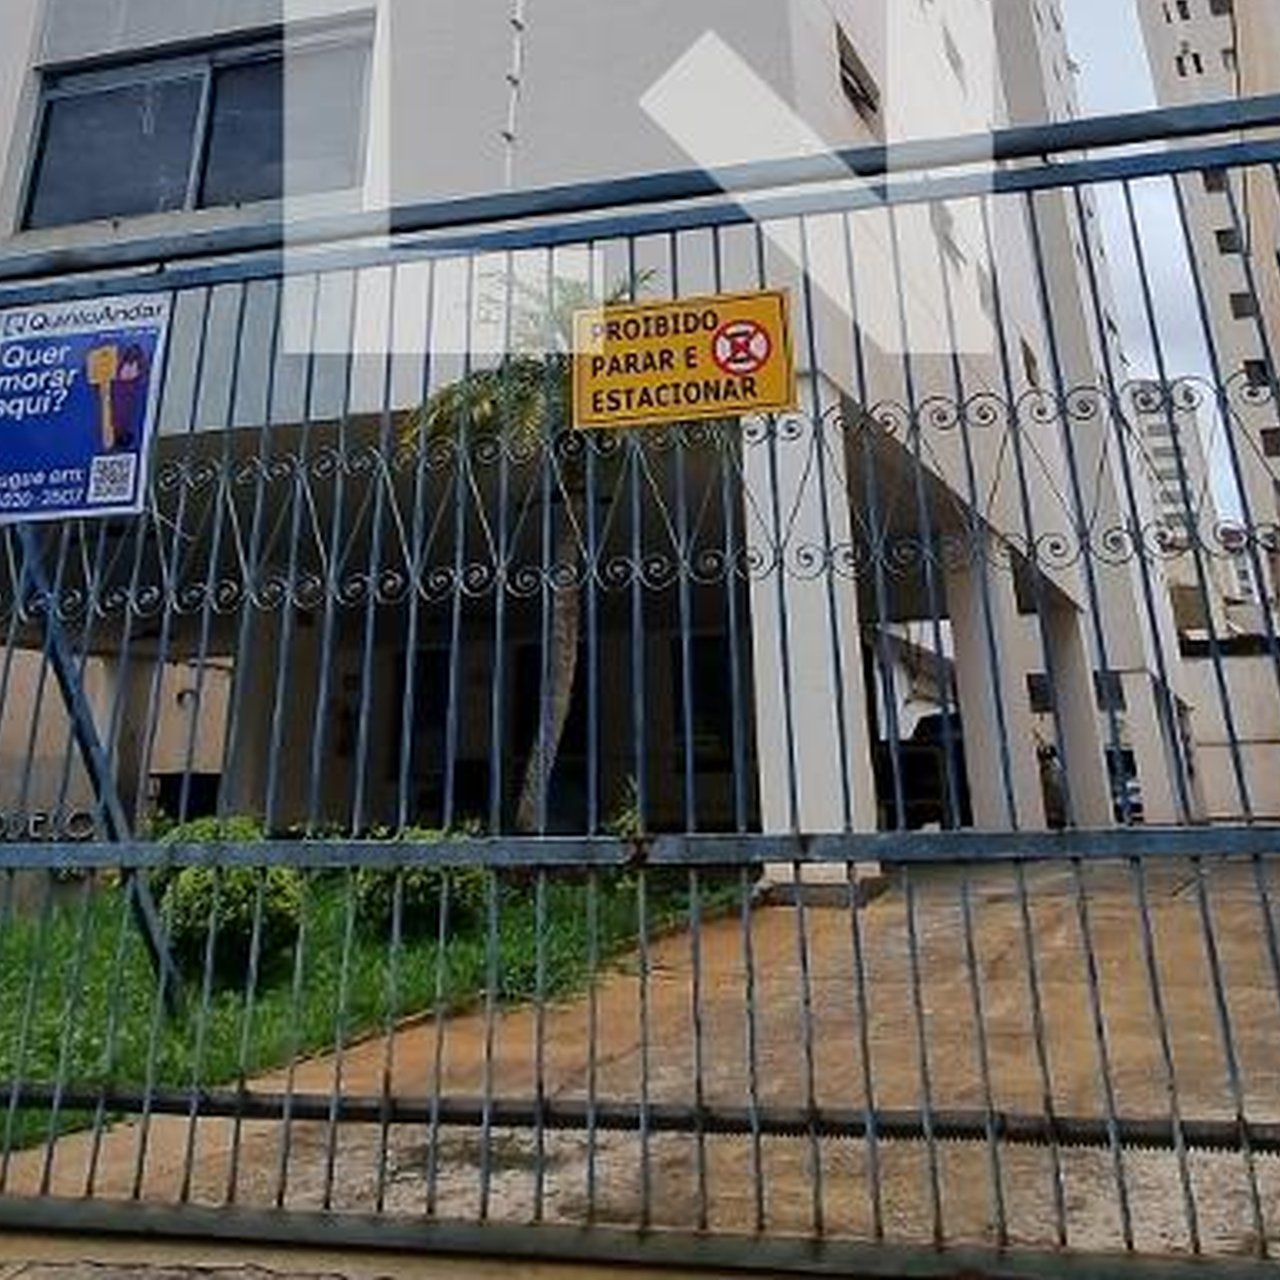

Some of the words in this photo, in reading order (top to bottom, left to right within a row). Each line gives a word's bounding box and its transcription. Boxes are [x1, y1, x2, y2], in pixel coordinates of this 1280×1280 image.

[591, 310, 719, 343] PROIBIDO
[1, 343, 72, 370] Quer
[591, 348, 675, 377] PARAR
[683, 345, 698, 369] E
[591, 376, 758, 413] ESTACIONAR
